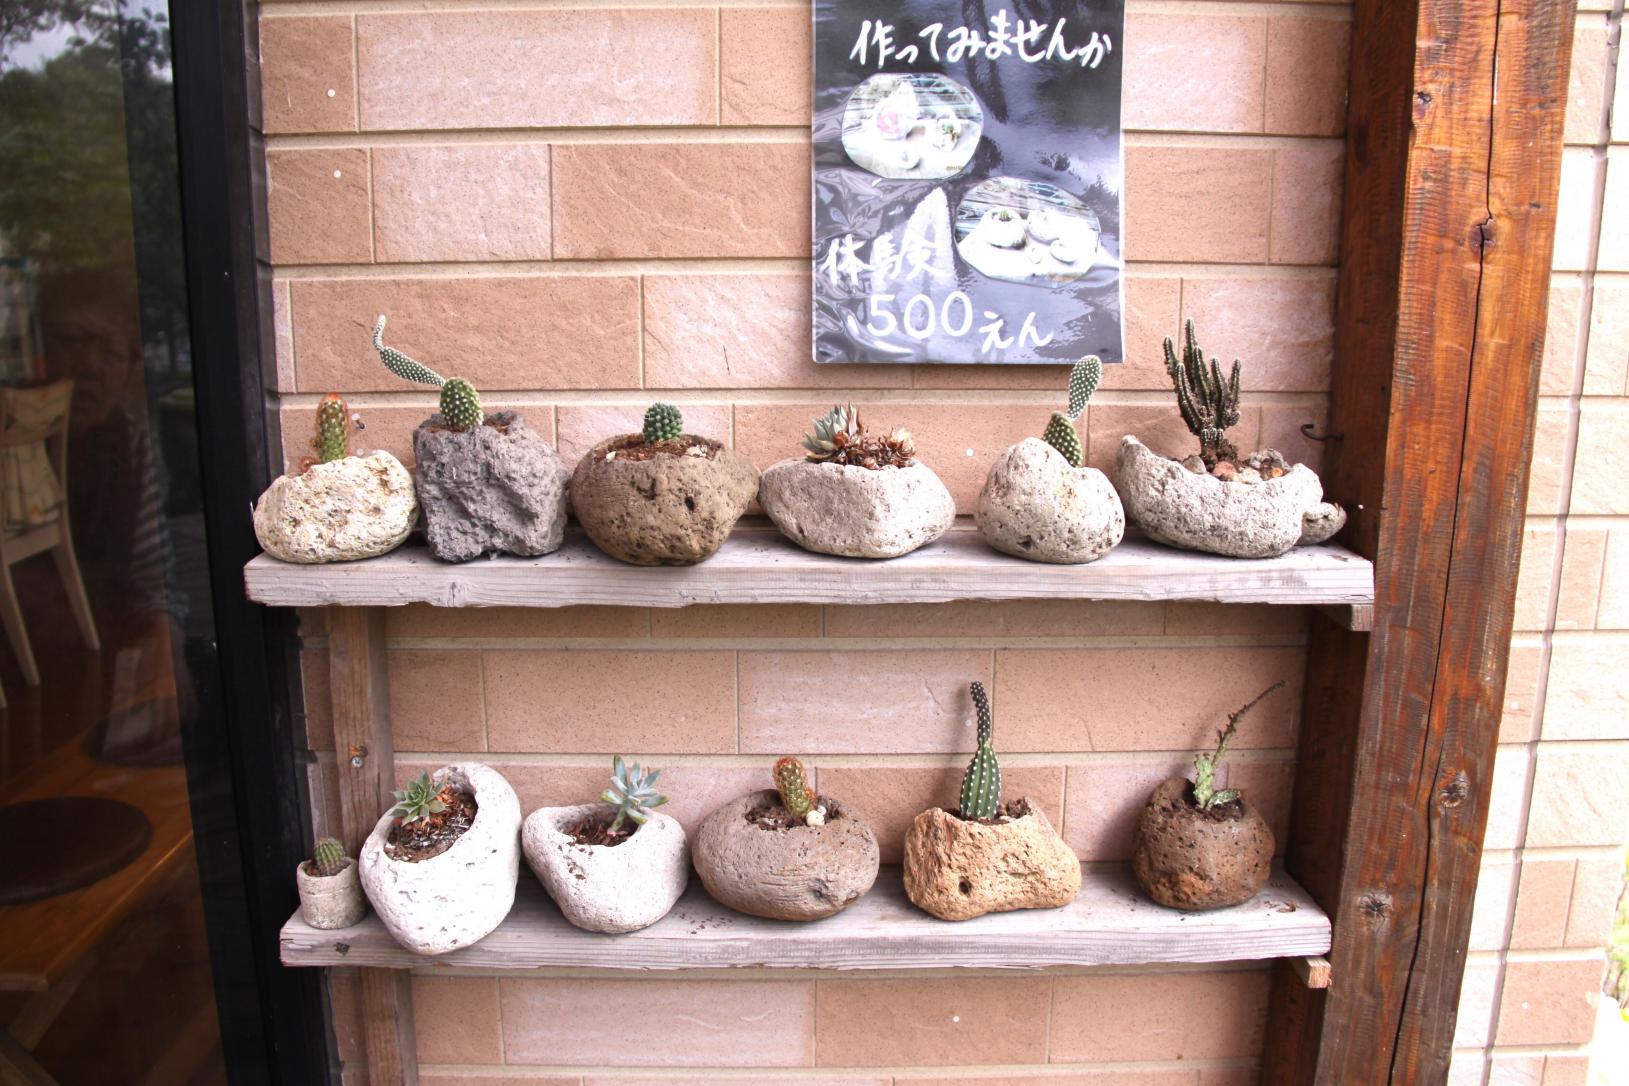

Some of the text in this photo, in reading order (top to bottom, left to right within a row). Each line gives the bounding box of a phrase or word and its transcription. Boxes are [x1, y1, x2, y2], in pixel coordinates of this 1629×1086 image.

[849, 9, 1112, 69] 作ってみませんか
[866, 290, 1053, 353] 500えん
